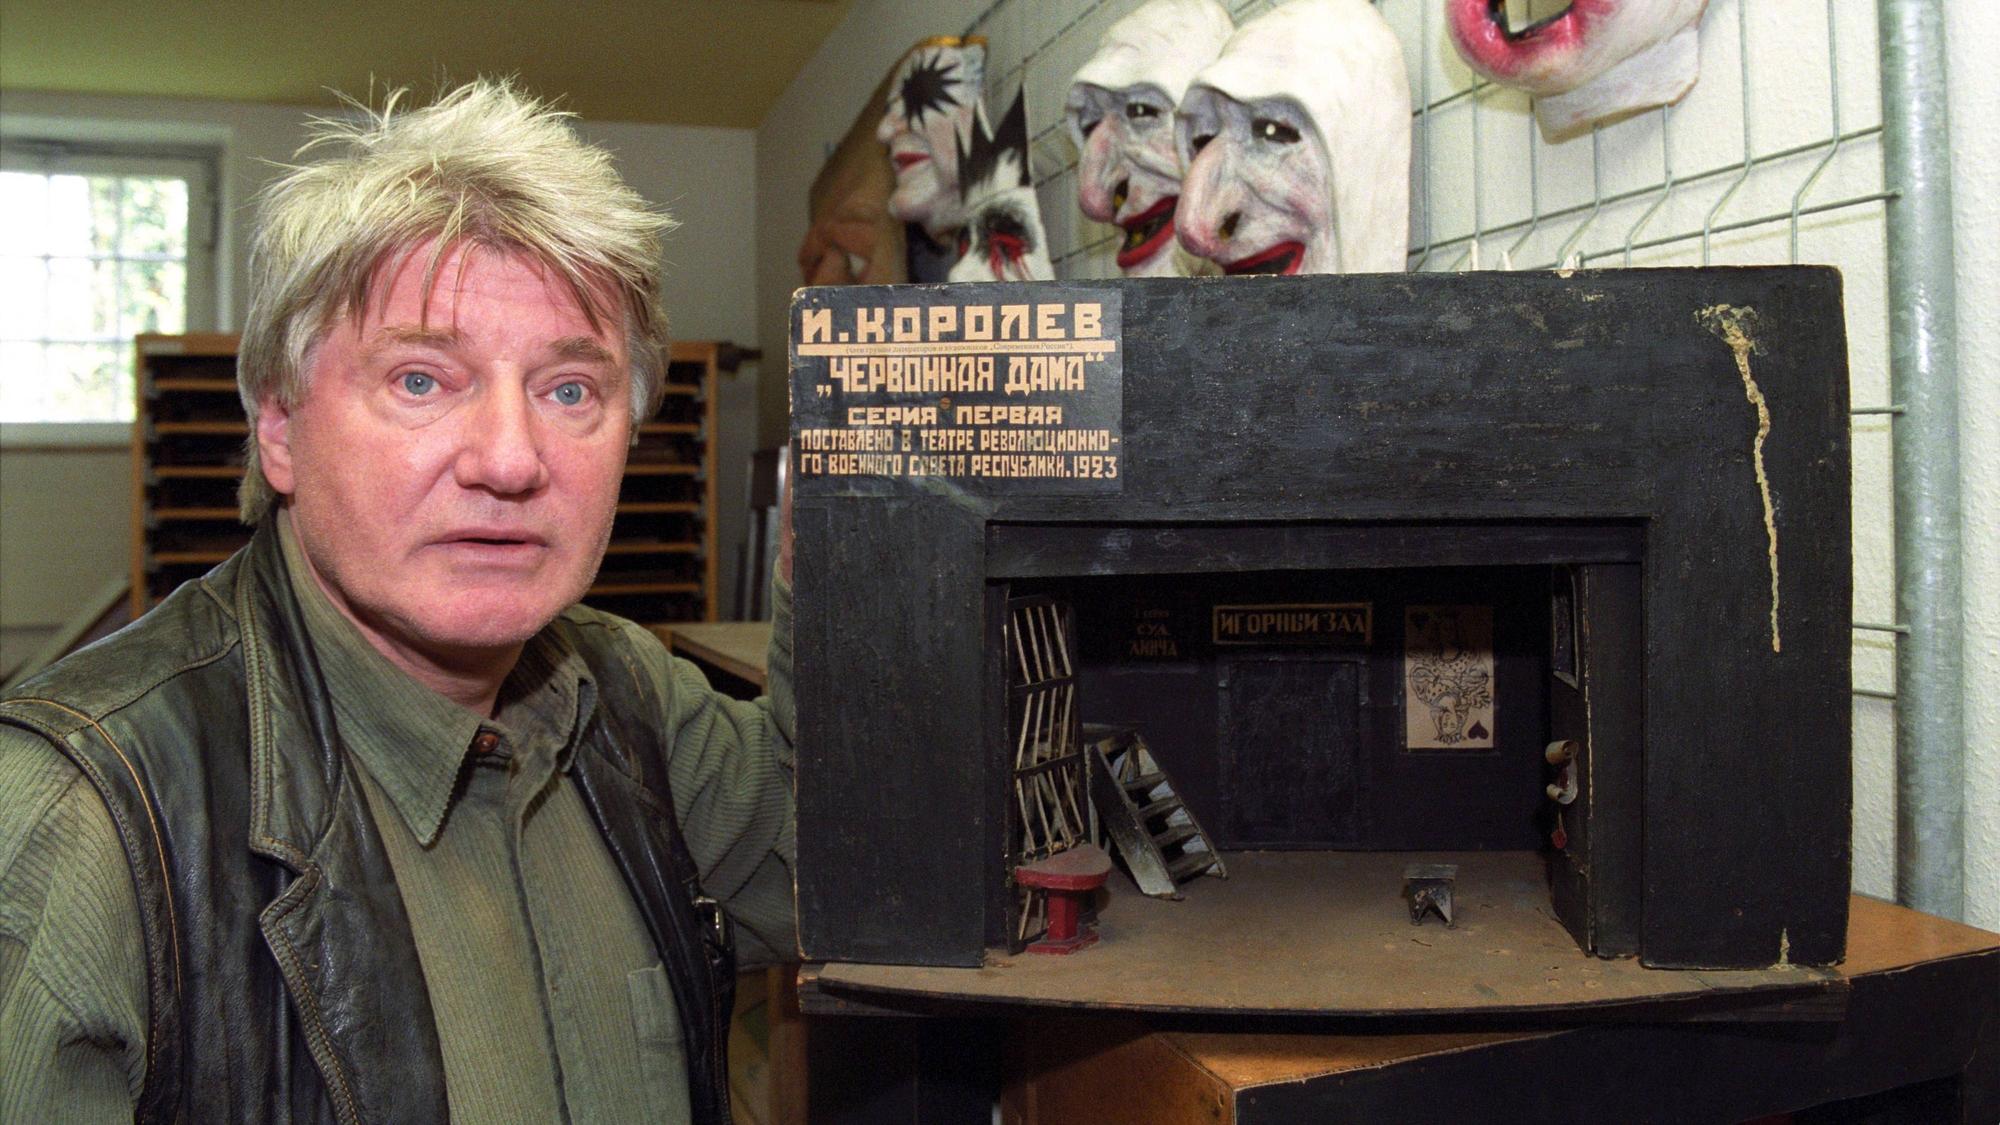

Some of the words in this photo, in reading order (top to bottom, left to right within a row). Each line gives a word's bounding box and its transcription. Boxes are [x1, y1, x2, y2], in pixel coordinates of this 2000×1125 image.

[802, 308, 850, 343] И.
[857, 303, 1102, 342] КОРОЛЕВ
[847, 407, 937, 425] СЕРИЯ
[956, 405, 1062, 424] ПЕРВАЯ
[800, 430, 894, 451] ПОСТАВЛЕНО
[901, 430, 911, 451] В
[920, 430, 974, 451] ТЕАТРЕ
[980, 430, 1119, 454] РЕВОЛЮЦИОННО-
[801, 454, 821, 474] ГО
[828, 454, 901, 475] ВОЕННОГО
[909, 455, 964, 475] СОВЕТА
[1321, 612, 1364, 634] ЗАЛ
